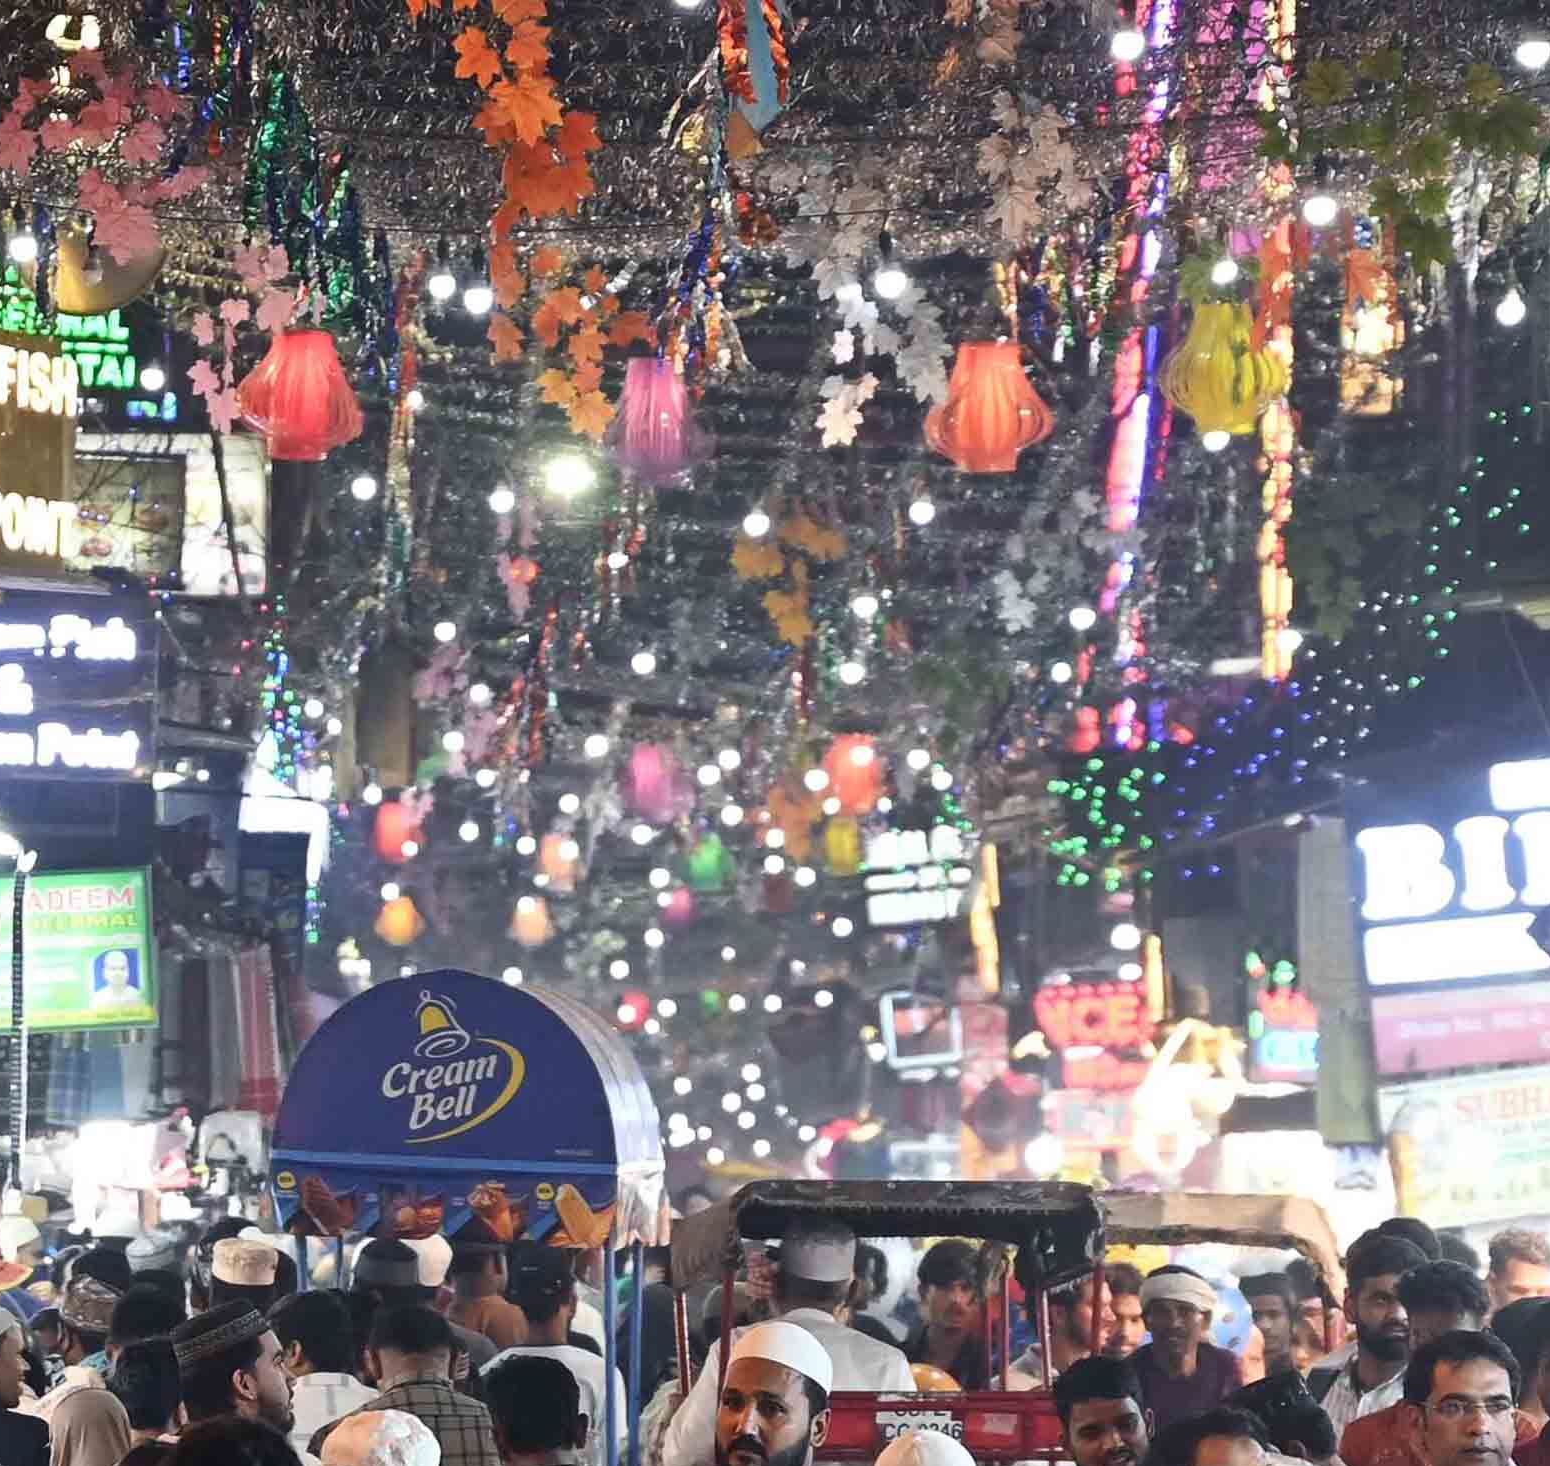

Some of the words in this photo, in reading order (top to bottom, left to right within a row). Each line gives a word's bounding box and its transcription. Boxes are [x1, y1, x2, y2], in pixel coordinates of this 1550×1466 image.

[27, 886, 137, 912] ADEEM
[382, 1052, 499, 1099] Cream
[409, 1085, 478, 1131] Bell
